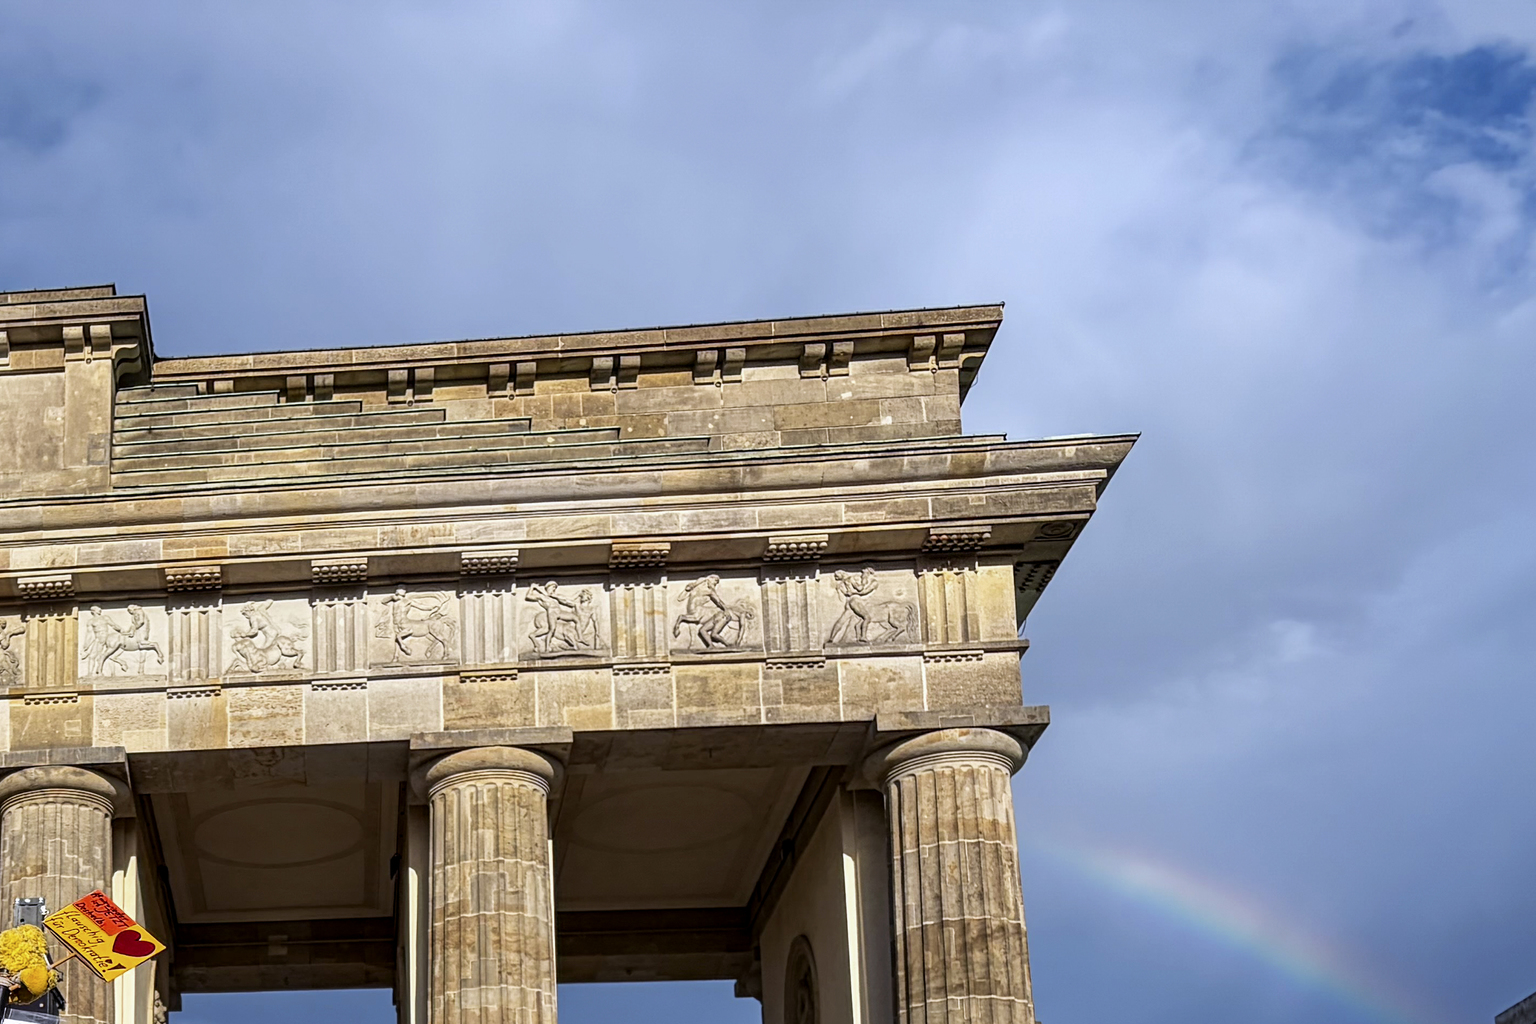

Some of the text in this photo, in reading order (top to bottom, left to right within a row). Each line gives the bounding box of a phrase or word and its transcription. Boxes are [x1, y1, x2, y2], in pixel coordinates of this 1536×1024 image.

[53, 910, 105, 944] flauschig
[94, 906, 130, 928] JETZT
[44, 917, 127, 973] für Demokratie!
